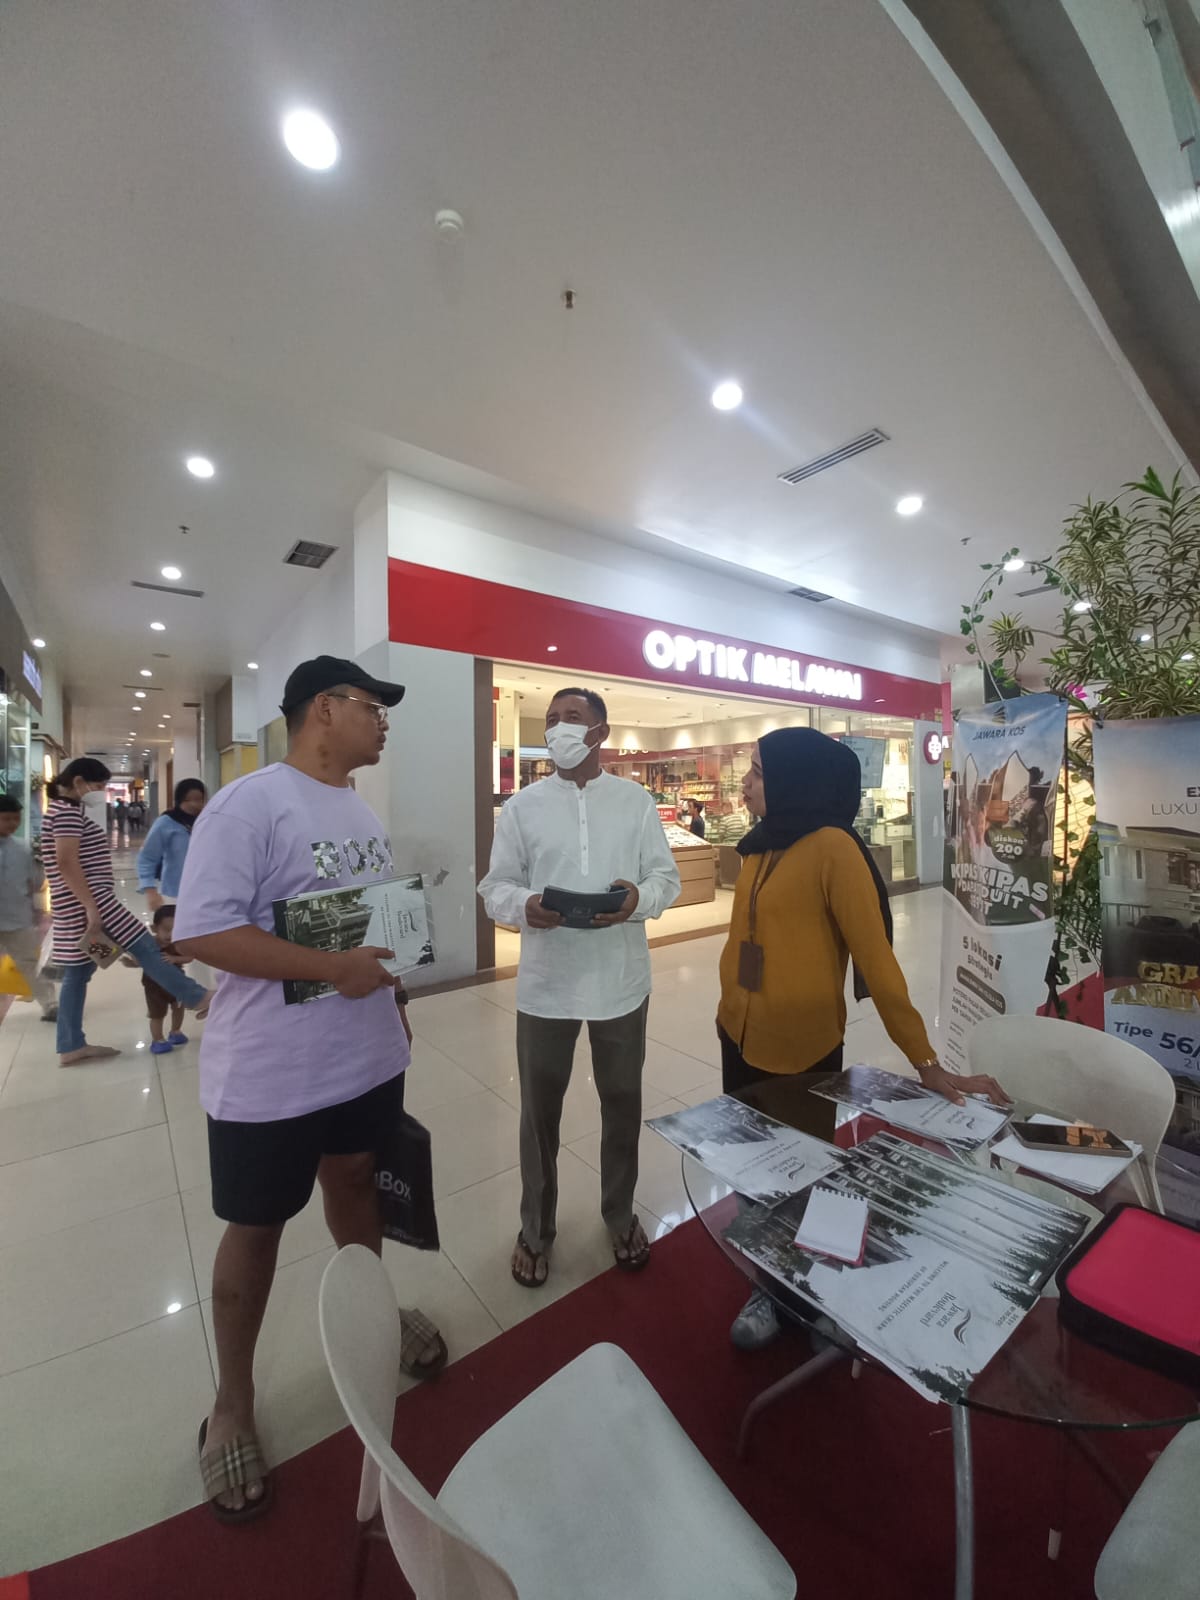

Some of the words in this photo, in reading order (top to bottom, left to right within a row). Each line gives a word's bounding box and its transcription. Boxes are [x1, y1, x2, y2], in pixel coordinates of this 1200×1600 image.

[643, 630, 748, 682] OPTIK
[973, 729, 1005, 740] JAWARA
[1008, 726, 1026, 736] KOS
[995, 843, 1023, 856] 200
[978, 866, 1048, 902] KIPAS
[963, 936, 969, 949] 5
[971, 938, 1002, 971] lokasi
[1114, 1021, 1153, 1038] Tipe
